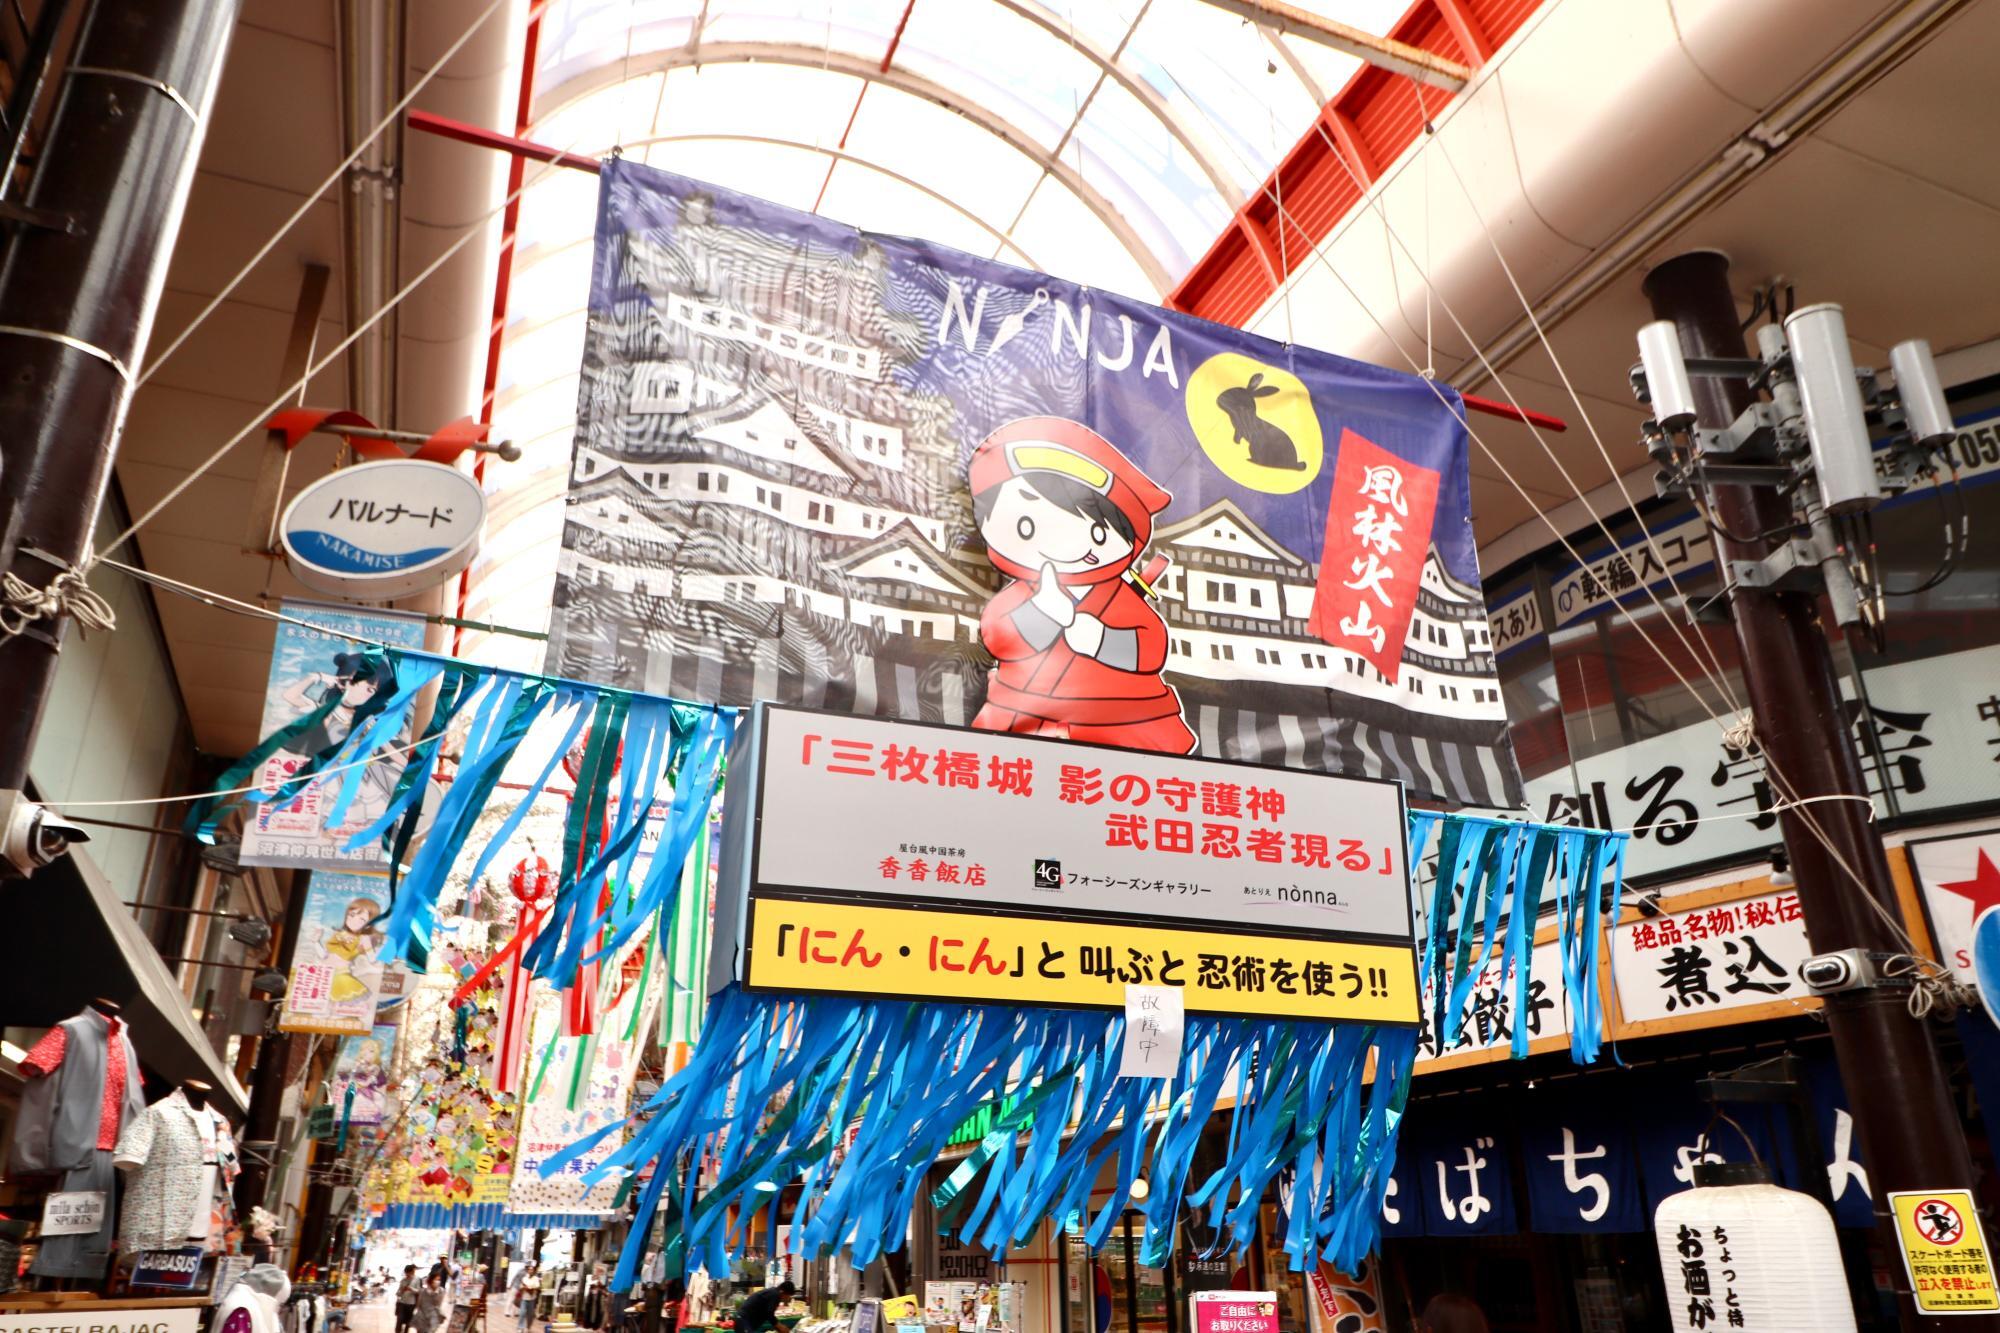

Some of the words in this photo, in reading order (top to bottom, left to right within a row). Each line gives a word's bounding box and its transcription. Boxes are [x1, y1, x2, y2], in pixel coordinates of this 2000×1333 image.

[317, 533, 406, 569] NAKAMISE
[1340, 465, 1409, 653] 風林火山
[802, 734, 1033, 798] 「三枚橋城
[1058, 764, 1286, 823] 影の守護神
[898, 843, 966, 858] 屋台風中国茶房
[1105, 812, 1393, 876] 武田忍者現る」
[878, 855, 987, 887] 香香飯店
[1036, 862, 1060, 883] 4G
[1067, 873, 1212, 896] フォーシーズンギャラリー
[1243, 886, 1271, 897] あとりえ
[1278, 885, 1337, 906] nònna
[1080, 945, 1186, 987] 叫ぶと
[1197, 952, 1389, 998] 忍術を使う!!
[54, 1214, 92, 1225] SPORTS
[138, 1252, 198, 1273] GARBASUS
